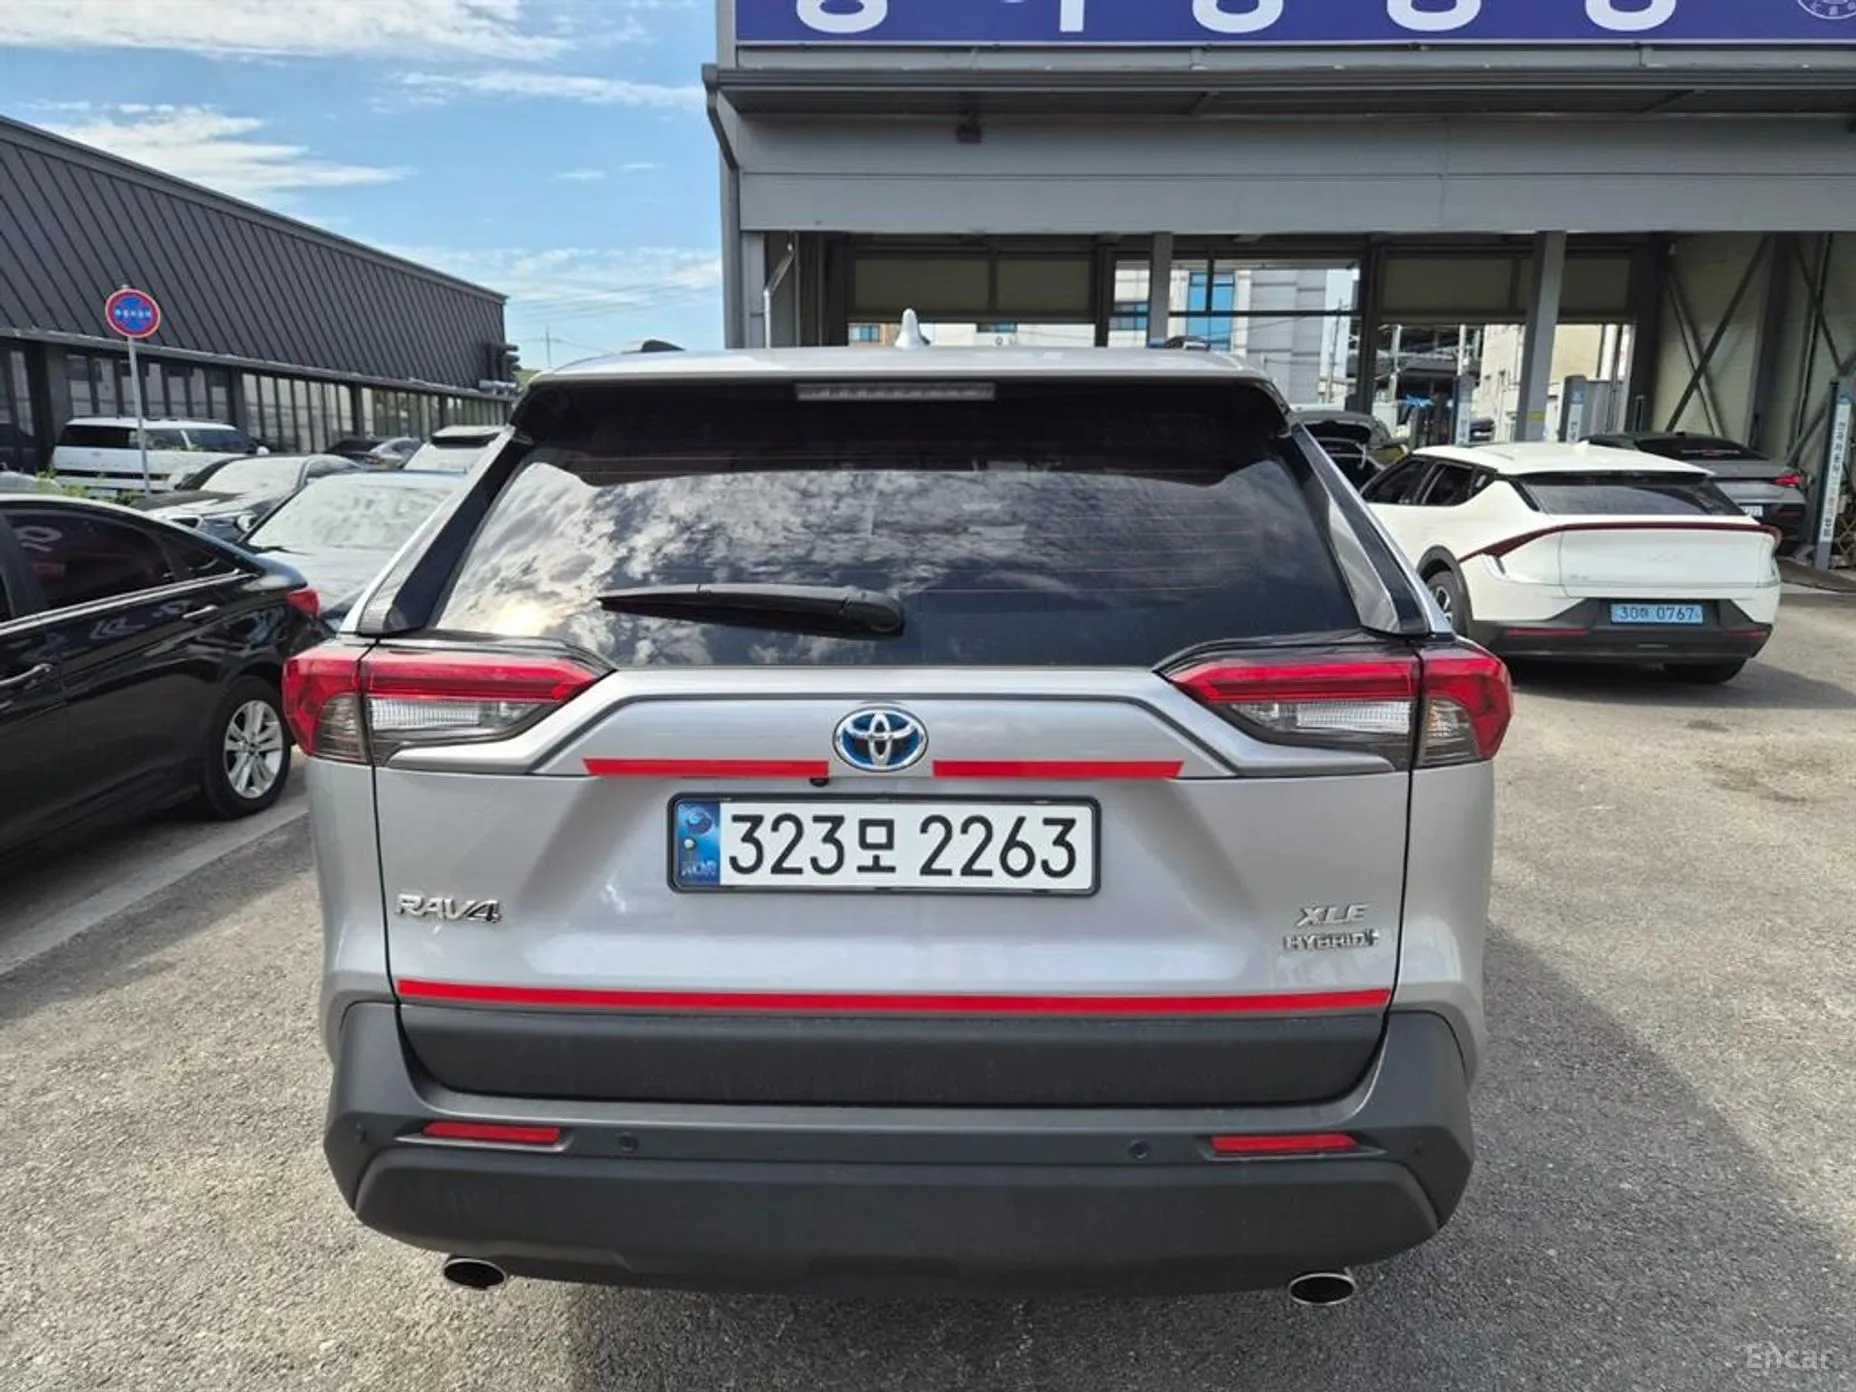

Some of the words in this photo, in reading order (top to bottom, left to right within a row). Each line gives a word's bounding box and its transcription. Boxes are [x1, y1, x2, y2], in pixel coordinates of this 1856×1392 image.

[1656, 606, 1694, 621] 0767
[729, 814, 897, 876] 323모
[919, 815, 1077, 879] 2263
[396, 893, 503, 922] RAV4
[1295, 903, 1370, 927] XLE
[1283, 931, 1367, 951] HYBRID
